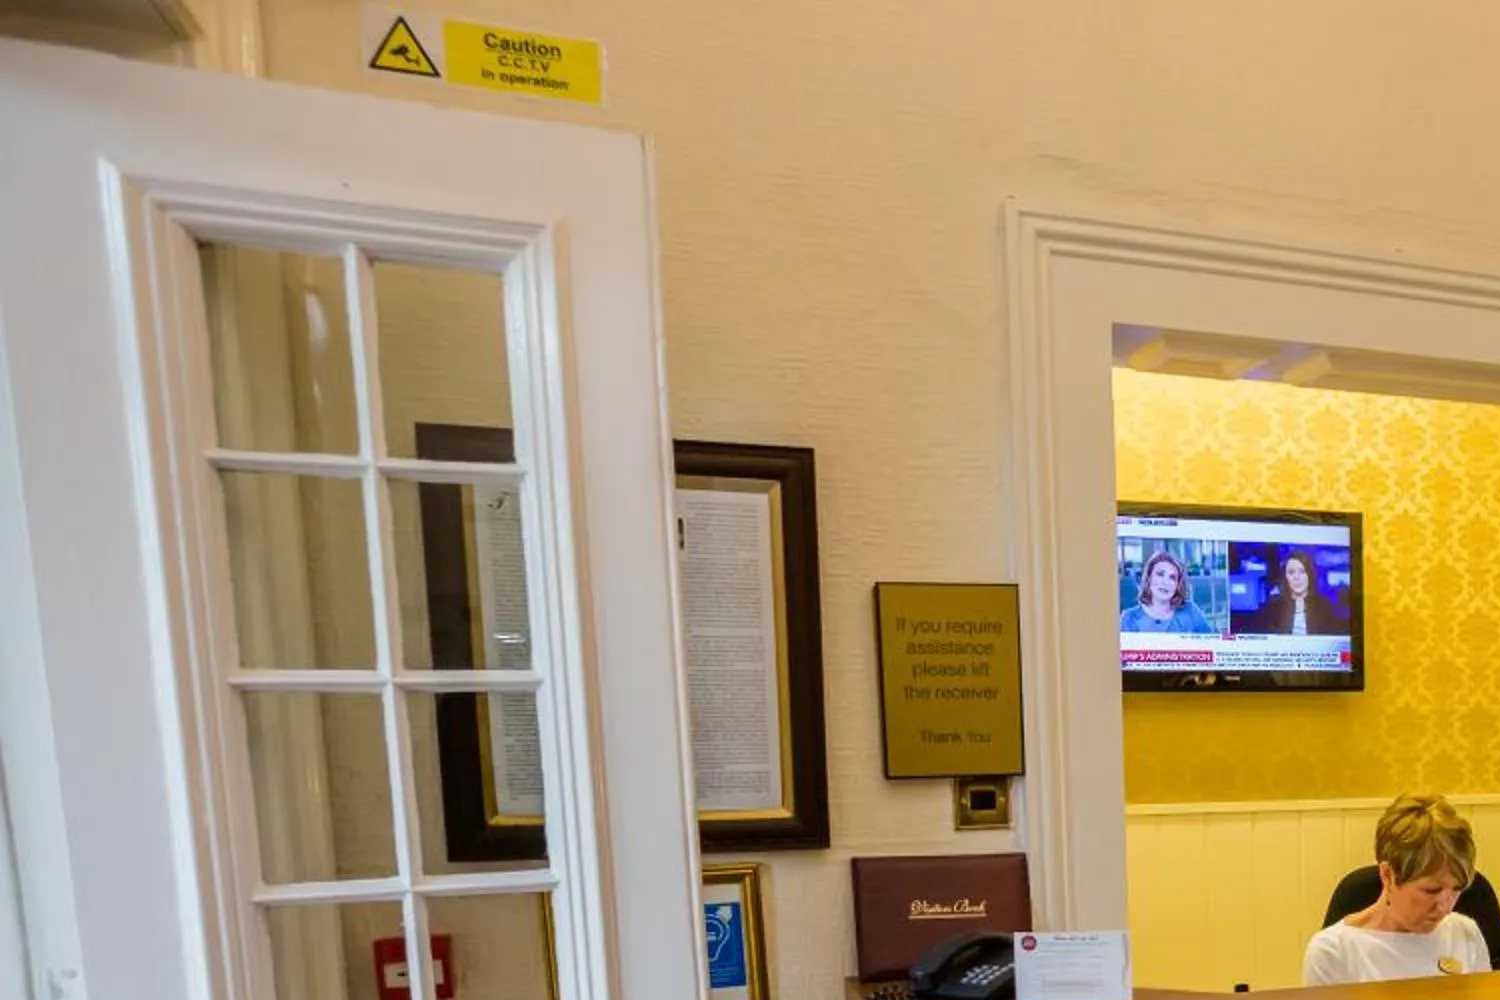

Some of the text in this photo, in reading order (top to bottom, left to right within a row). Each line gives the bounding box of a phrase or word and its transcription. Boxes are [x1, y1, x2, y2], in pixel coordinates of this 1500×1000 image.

[483, 31, 562, 60] Caution
[499, 70, 570, 91] operation
[911, 620, 942, 637] you
[945, 619, 1003, 637] require
[905, 640, 994, 655] assistance
[911, 661, 968, 679] please
[903, 685, 999, 700] the receiver
[920, 729, 963, 744] Thank
